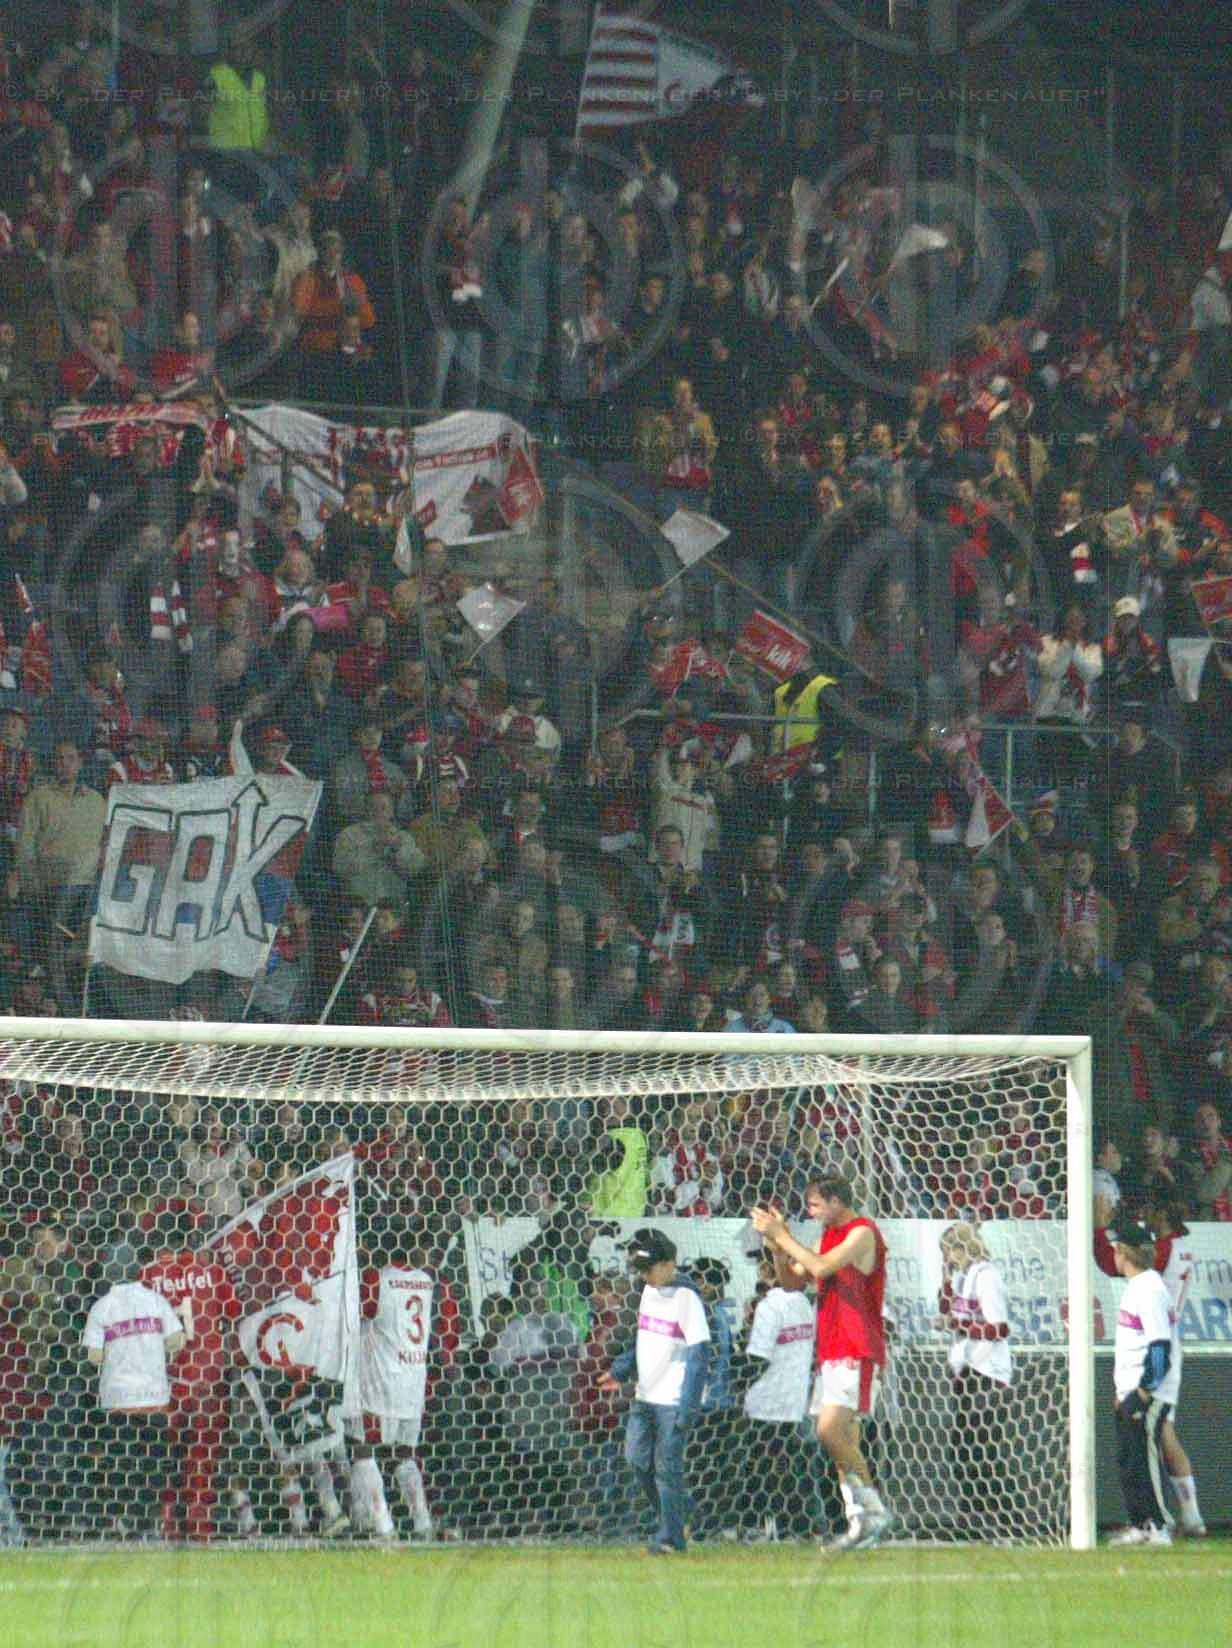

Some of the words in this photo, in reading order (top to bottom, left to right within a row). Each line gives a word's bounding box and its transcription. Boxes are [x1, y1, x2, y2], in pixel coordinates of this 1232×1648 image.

[96, 779, 307, 944] GAK
[152, 1271, 213, 1293] Teufel
[405, 1295, 425, 1345] 3
